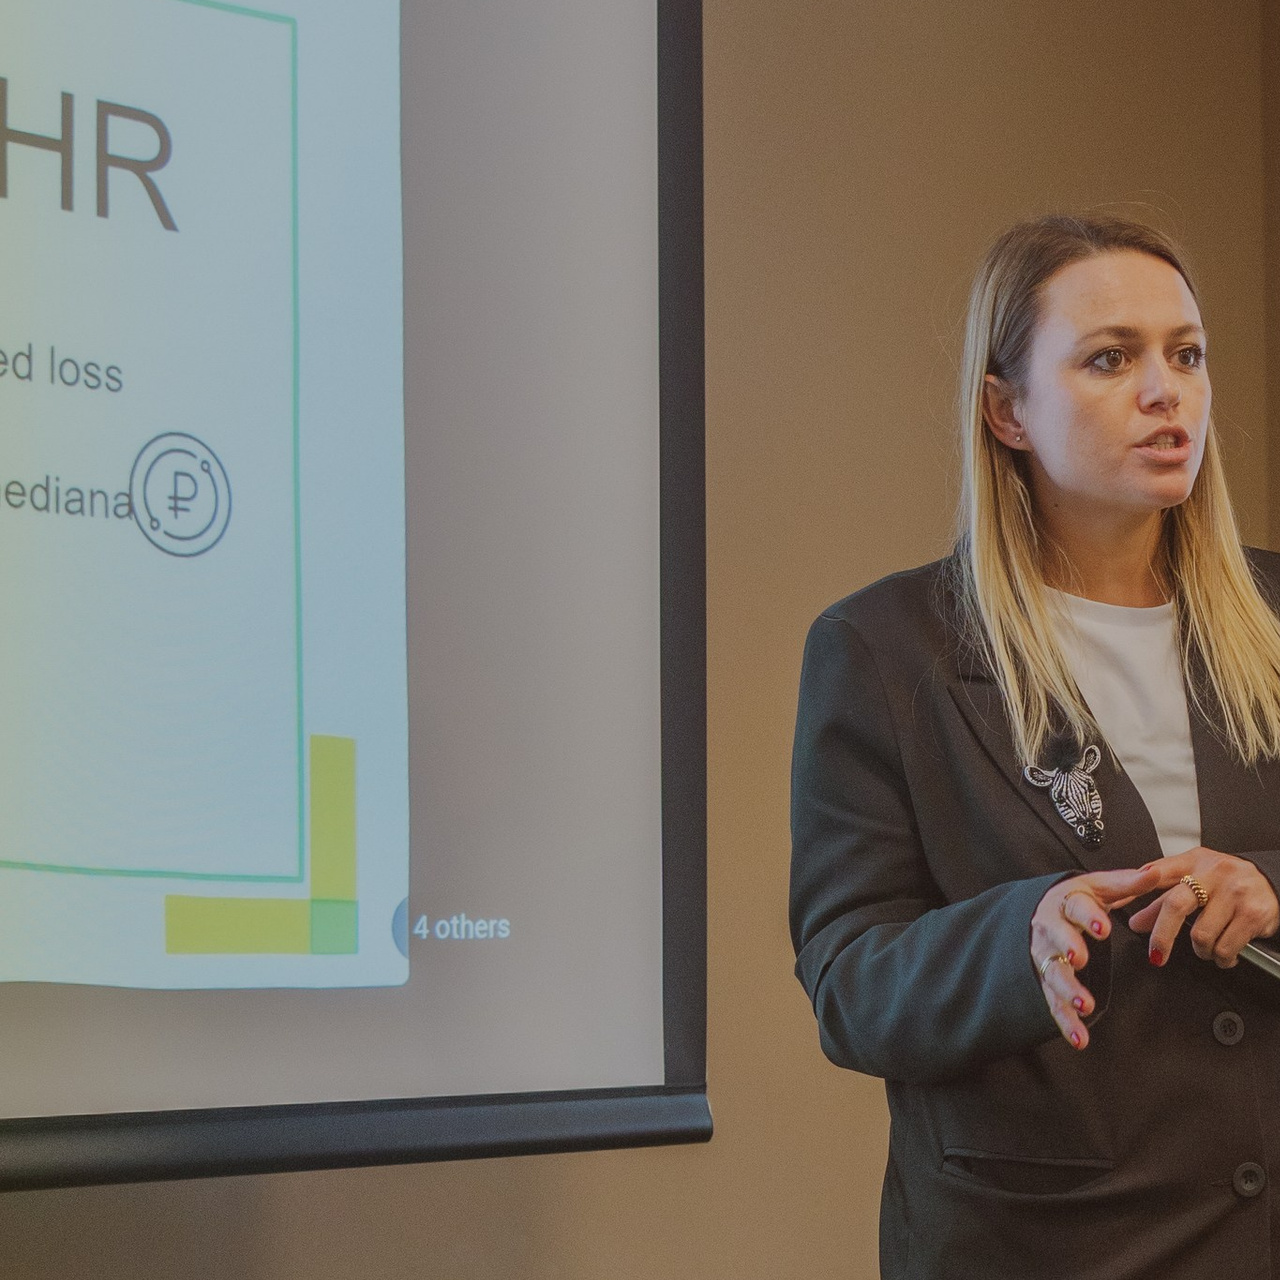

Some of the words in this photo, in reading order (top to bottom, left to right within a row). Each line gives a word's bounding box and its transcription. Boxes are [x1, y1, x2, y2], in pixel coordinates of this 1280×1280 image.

[0, 76, 179, 233] HR
[50, 345, 123, 393] loss
[413, 914, 429, 939] 4
[435, 913, 510, 939] others
